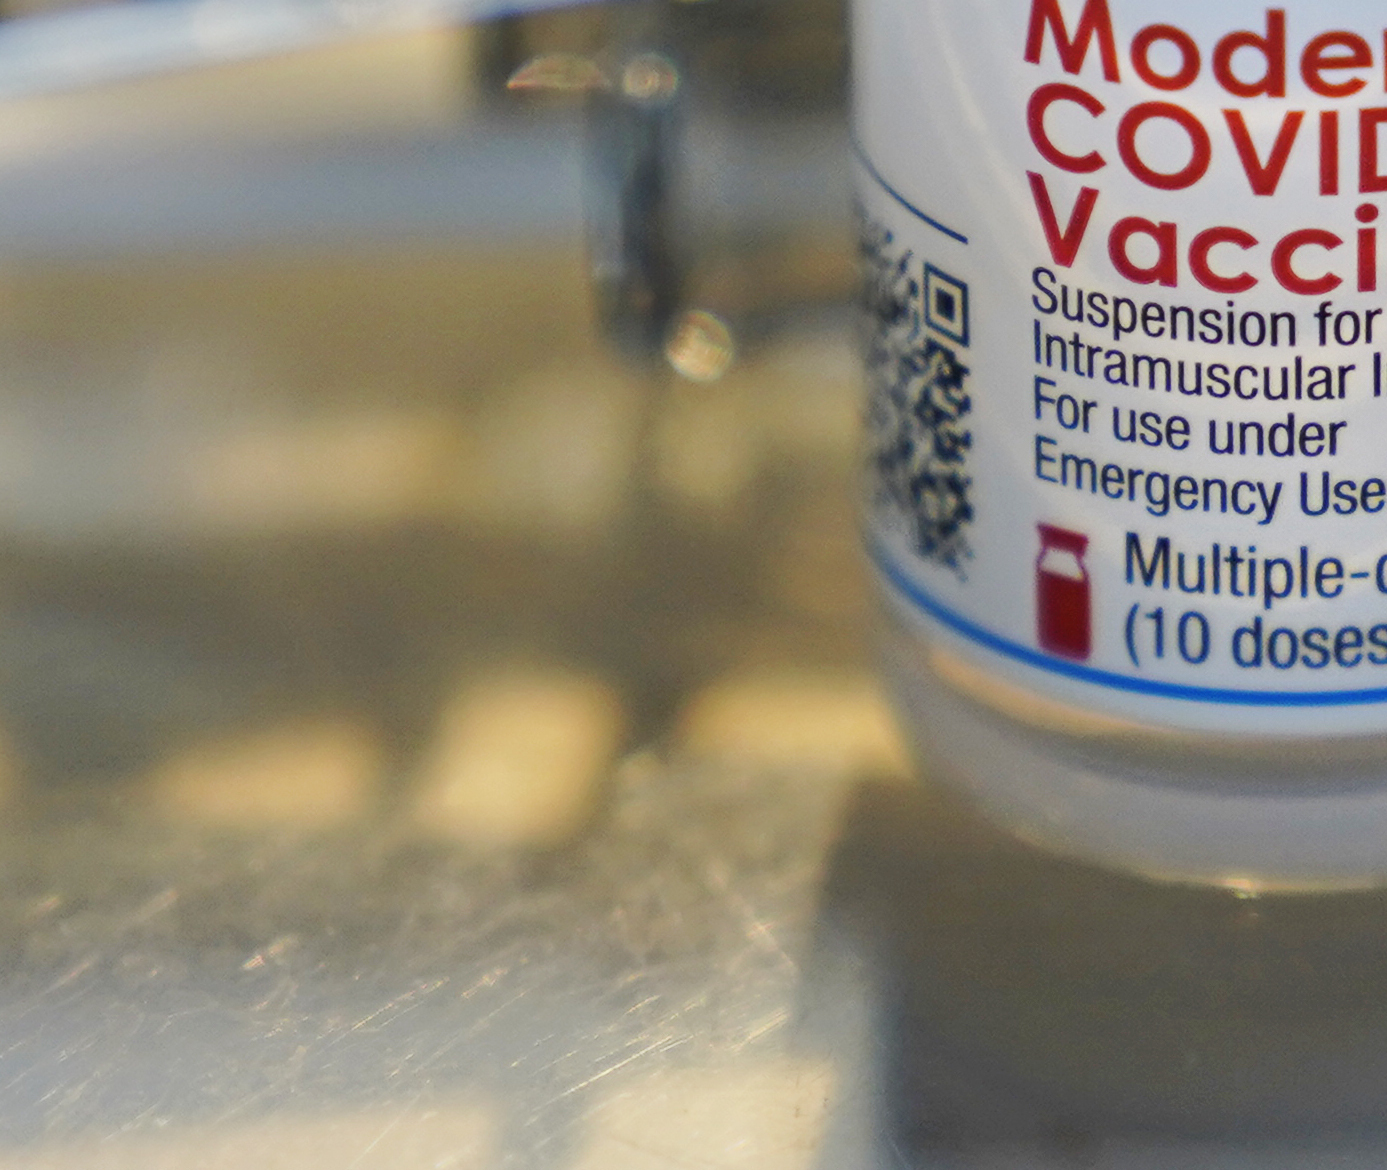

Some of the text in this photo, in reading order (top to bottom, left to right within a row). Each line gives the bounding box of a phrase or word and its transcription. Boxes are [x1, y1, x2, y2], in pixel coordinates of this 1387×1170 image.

[1030, 268, 1383, 347] Suspension for
[1031, 322, 1355, 401] Intramuscular
[1033, 377, 1348, 457] For use under
[1034, 437, 1282, 526] Emergency
[1298, 472, 1387, 519] Use
[1124, 603, 1211, 667] (10
